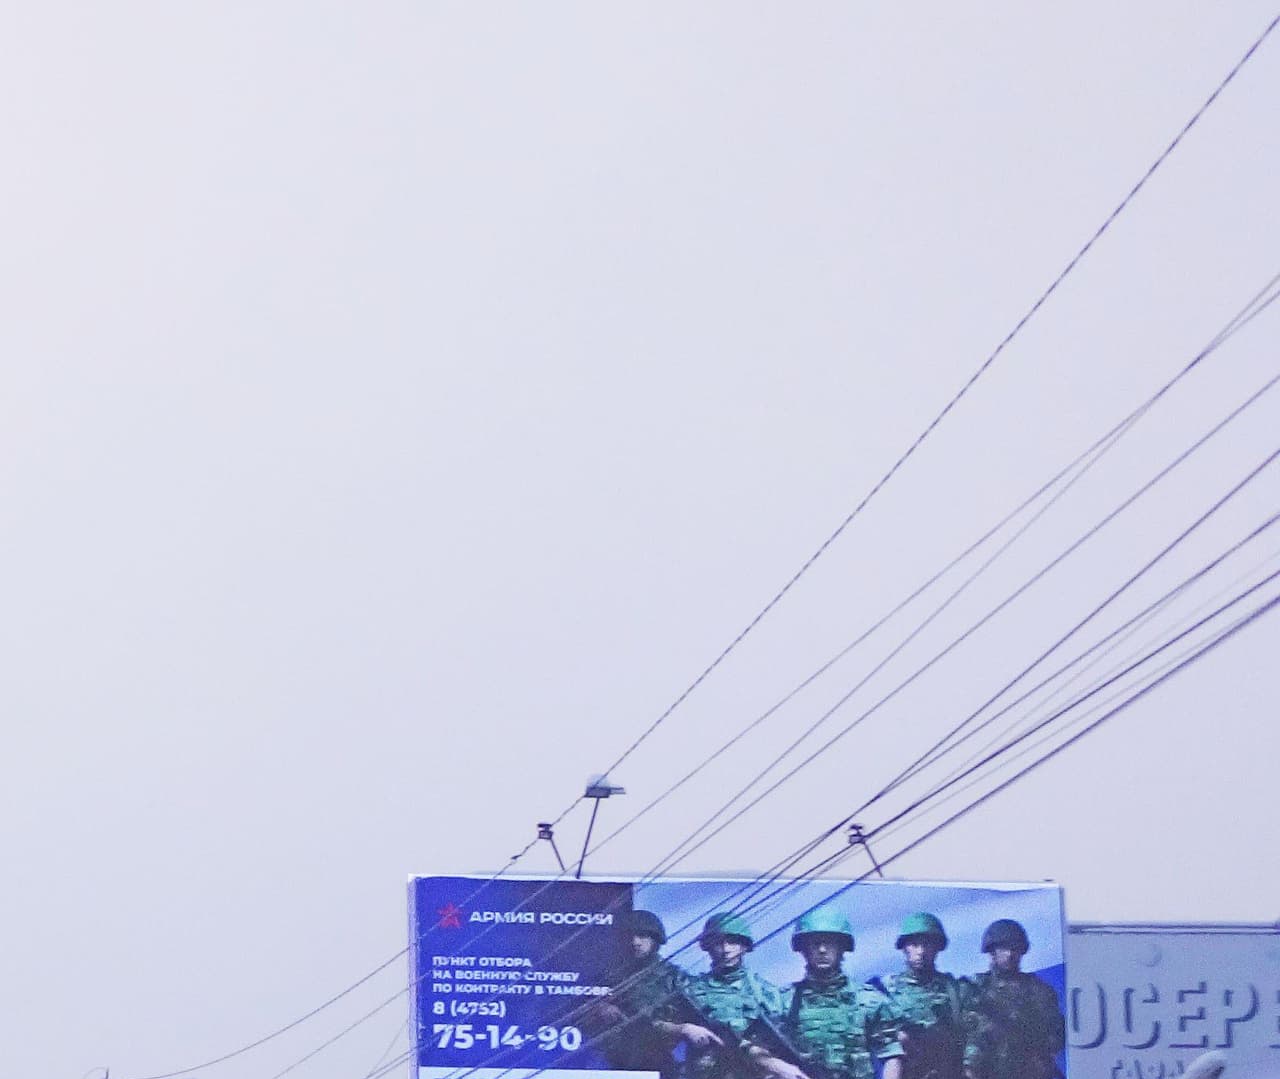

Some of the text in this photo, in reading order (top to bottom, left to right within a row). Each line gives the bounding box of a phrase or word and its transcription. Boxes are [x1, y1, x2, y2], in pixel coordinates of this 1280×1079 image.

[469, 911, 613, 925] АРМИЯ РОССИИ
[432, 956, 532, 967] ПУНКТ ОТБОРА
[433, 970, 580, 982] НА ВОЕННУЮ СЛУЖБУ
[433, 984, 452, 993] ПО
[455, 984, 530, 995] КОНТРАКТУ
[535, 985, 544, 994] В
[433, 1001, 506, 1018] 8 (4752)
[433, 1024, 583, 1051] 75-14-90
